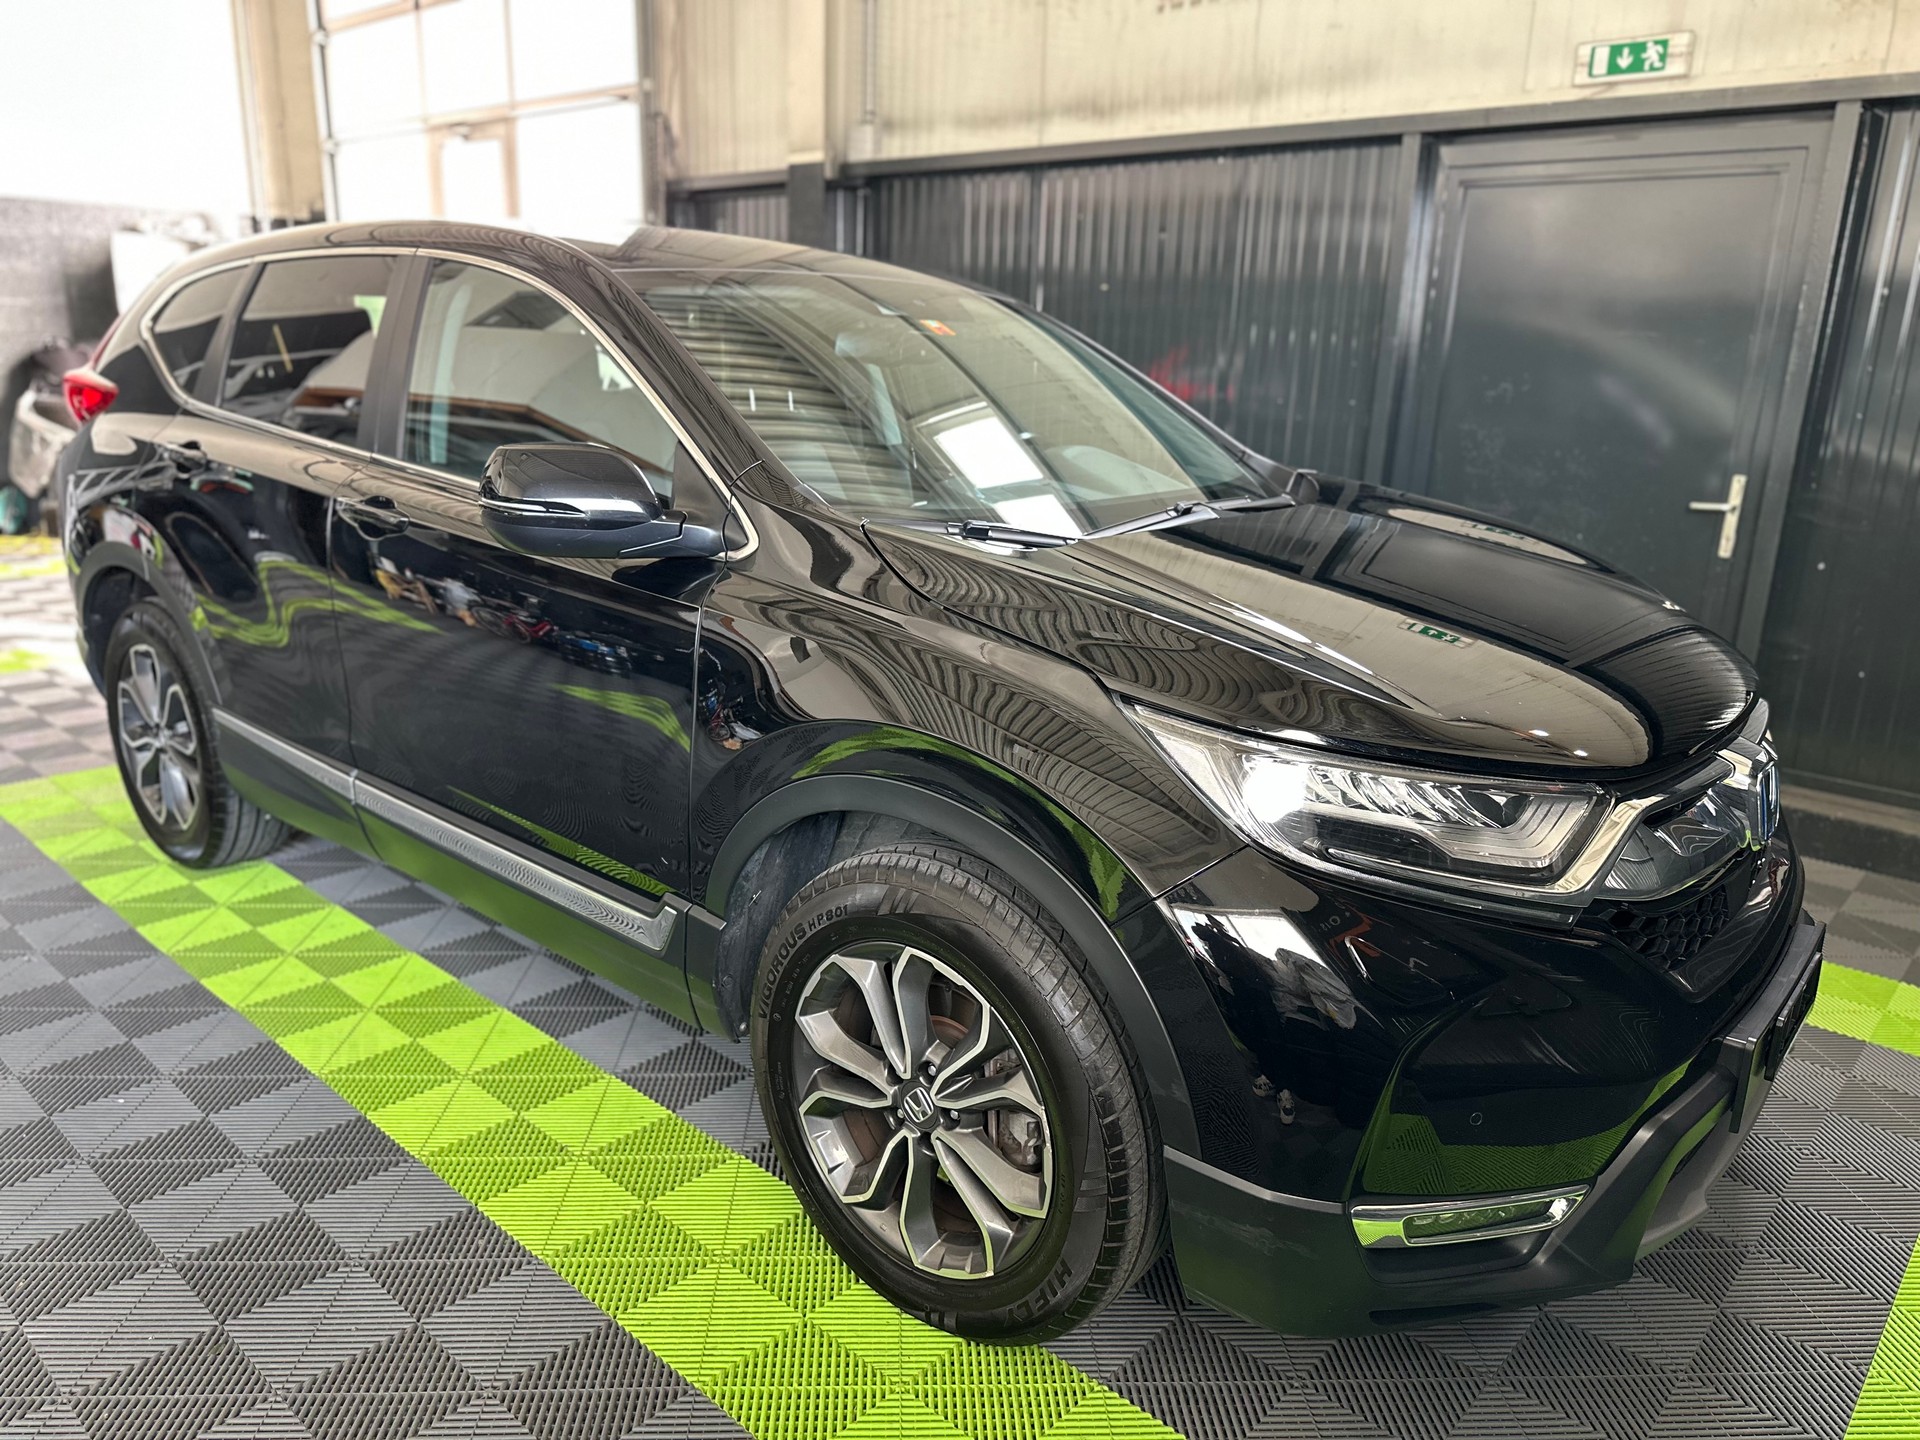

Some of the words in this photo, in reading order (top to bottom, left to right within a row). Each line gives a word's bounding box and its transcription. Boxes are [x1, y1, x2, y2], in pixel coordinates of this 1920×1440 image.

[758, 922, 807, 1019] VIGOROUS
[807, 904, 849, 931] HP801
[1005, 1257, 1073, 1324] HIFLY
